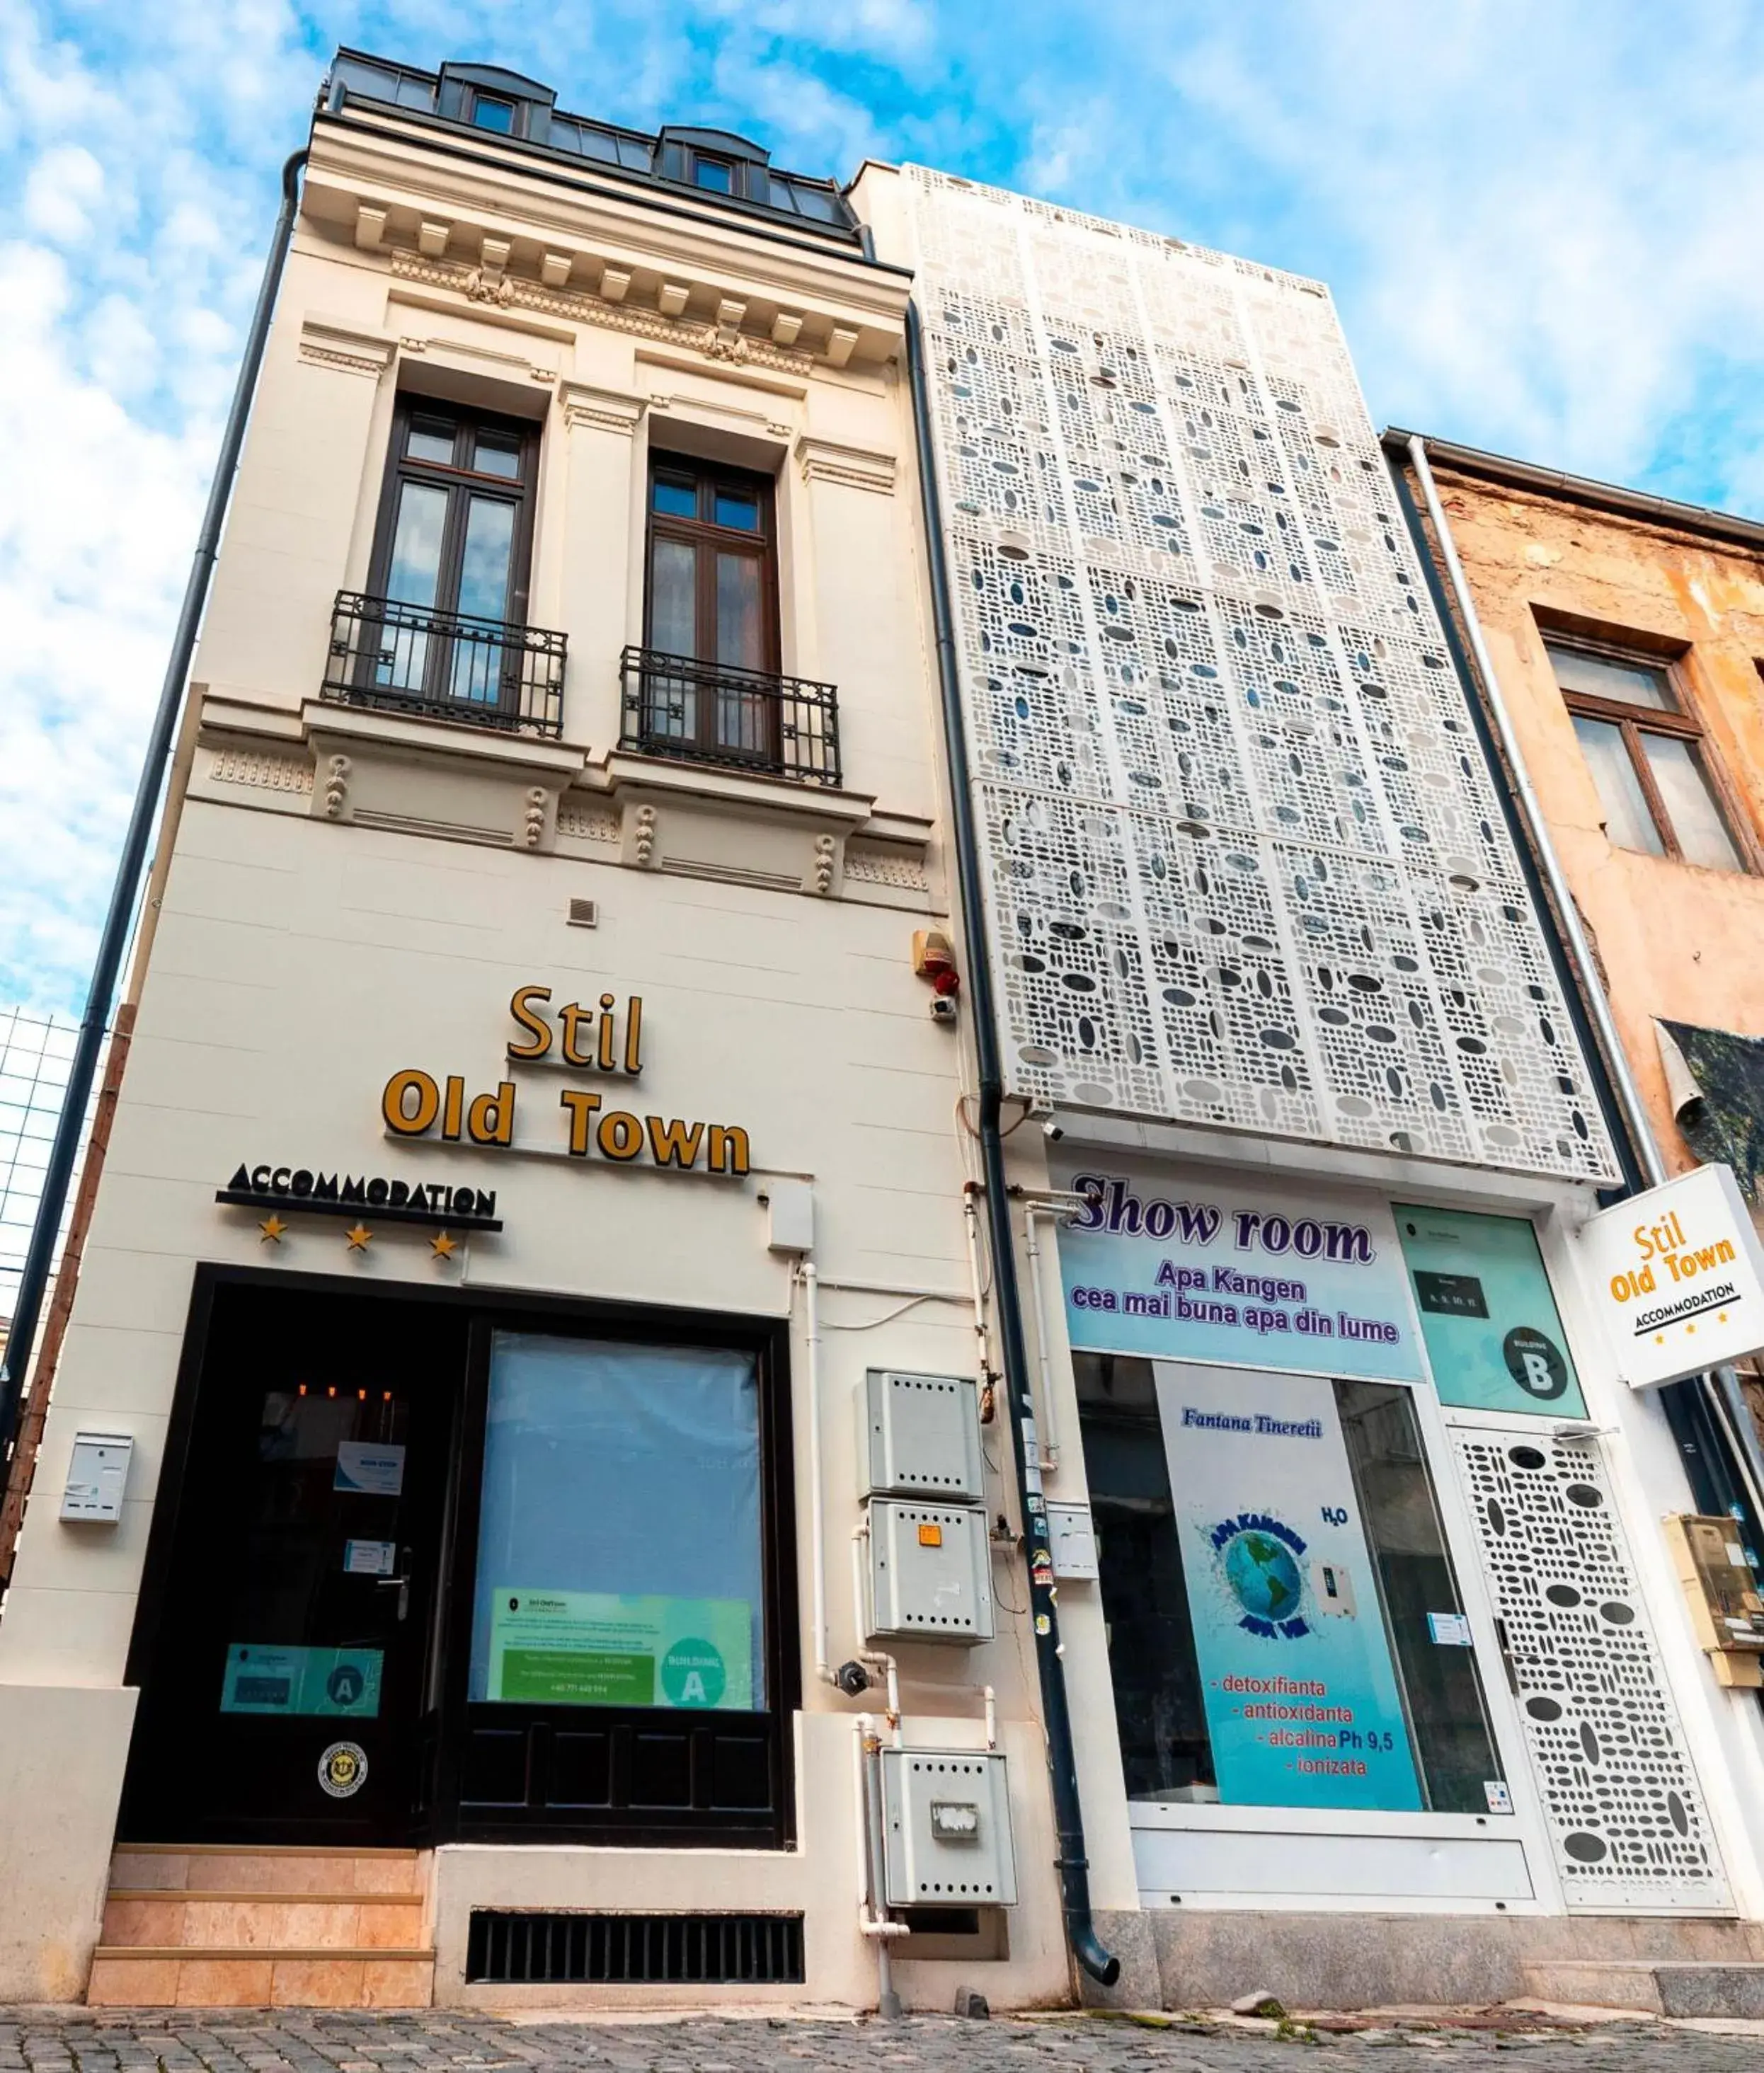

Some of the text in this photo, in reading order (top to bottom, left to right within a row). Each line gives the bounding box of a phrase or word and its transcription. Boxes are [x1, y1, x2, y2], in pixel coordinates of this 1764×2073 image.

[507, 985, 643, 1075] Stil
[382, 1069, 750, 1176] Old Town
[227, 1163, 497, 1218] ACCOMMODATION
[1072, 1174, 1377, 1265] Show room
[1633, 1211, 1687, 1261] Stil
[1155, 1261, 1307, 1303] Apa Kangen
[1610, 1239, 1736, 1302] Old Town
[1071, 1285, 1400, 1345] cea mai buna apa din lume
[1635, 1282, 1735, 1328] ACCOMMODATION
[1522, 1353, 1554, 1391] B
[1182, 1406, 1251, 1431] Fantana
[334, 1677, 353, 1700] A
[681, 1670, 707, 1702] A
[1222, 1675, 1326, 1696] detoxifianta
[1244, 1702, 1353, 1723] antioxidanta
[1268, 1728, 1337, 1748] alcalina
[1339, 1730, 1363, 1750] Ph
[1368, 1731, 1394, 1753] 9,5
[1298, 1755, 1368, 1776] ionizata
